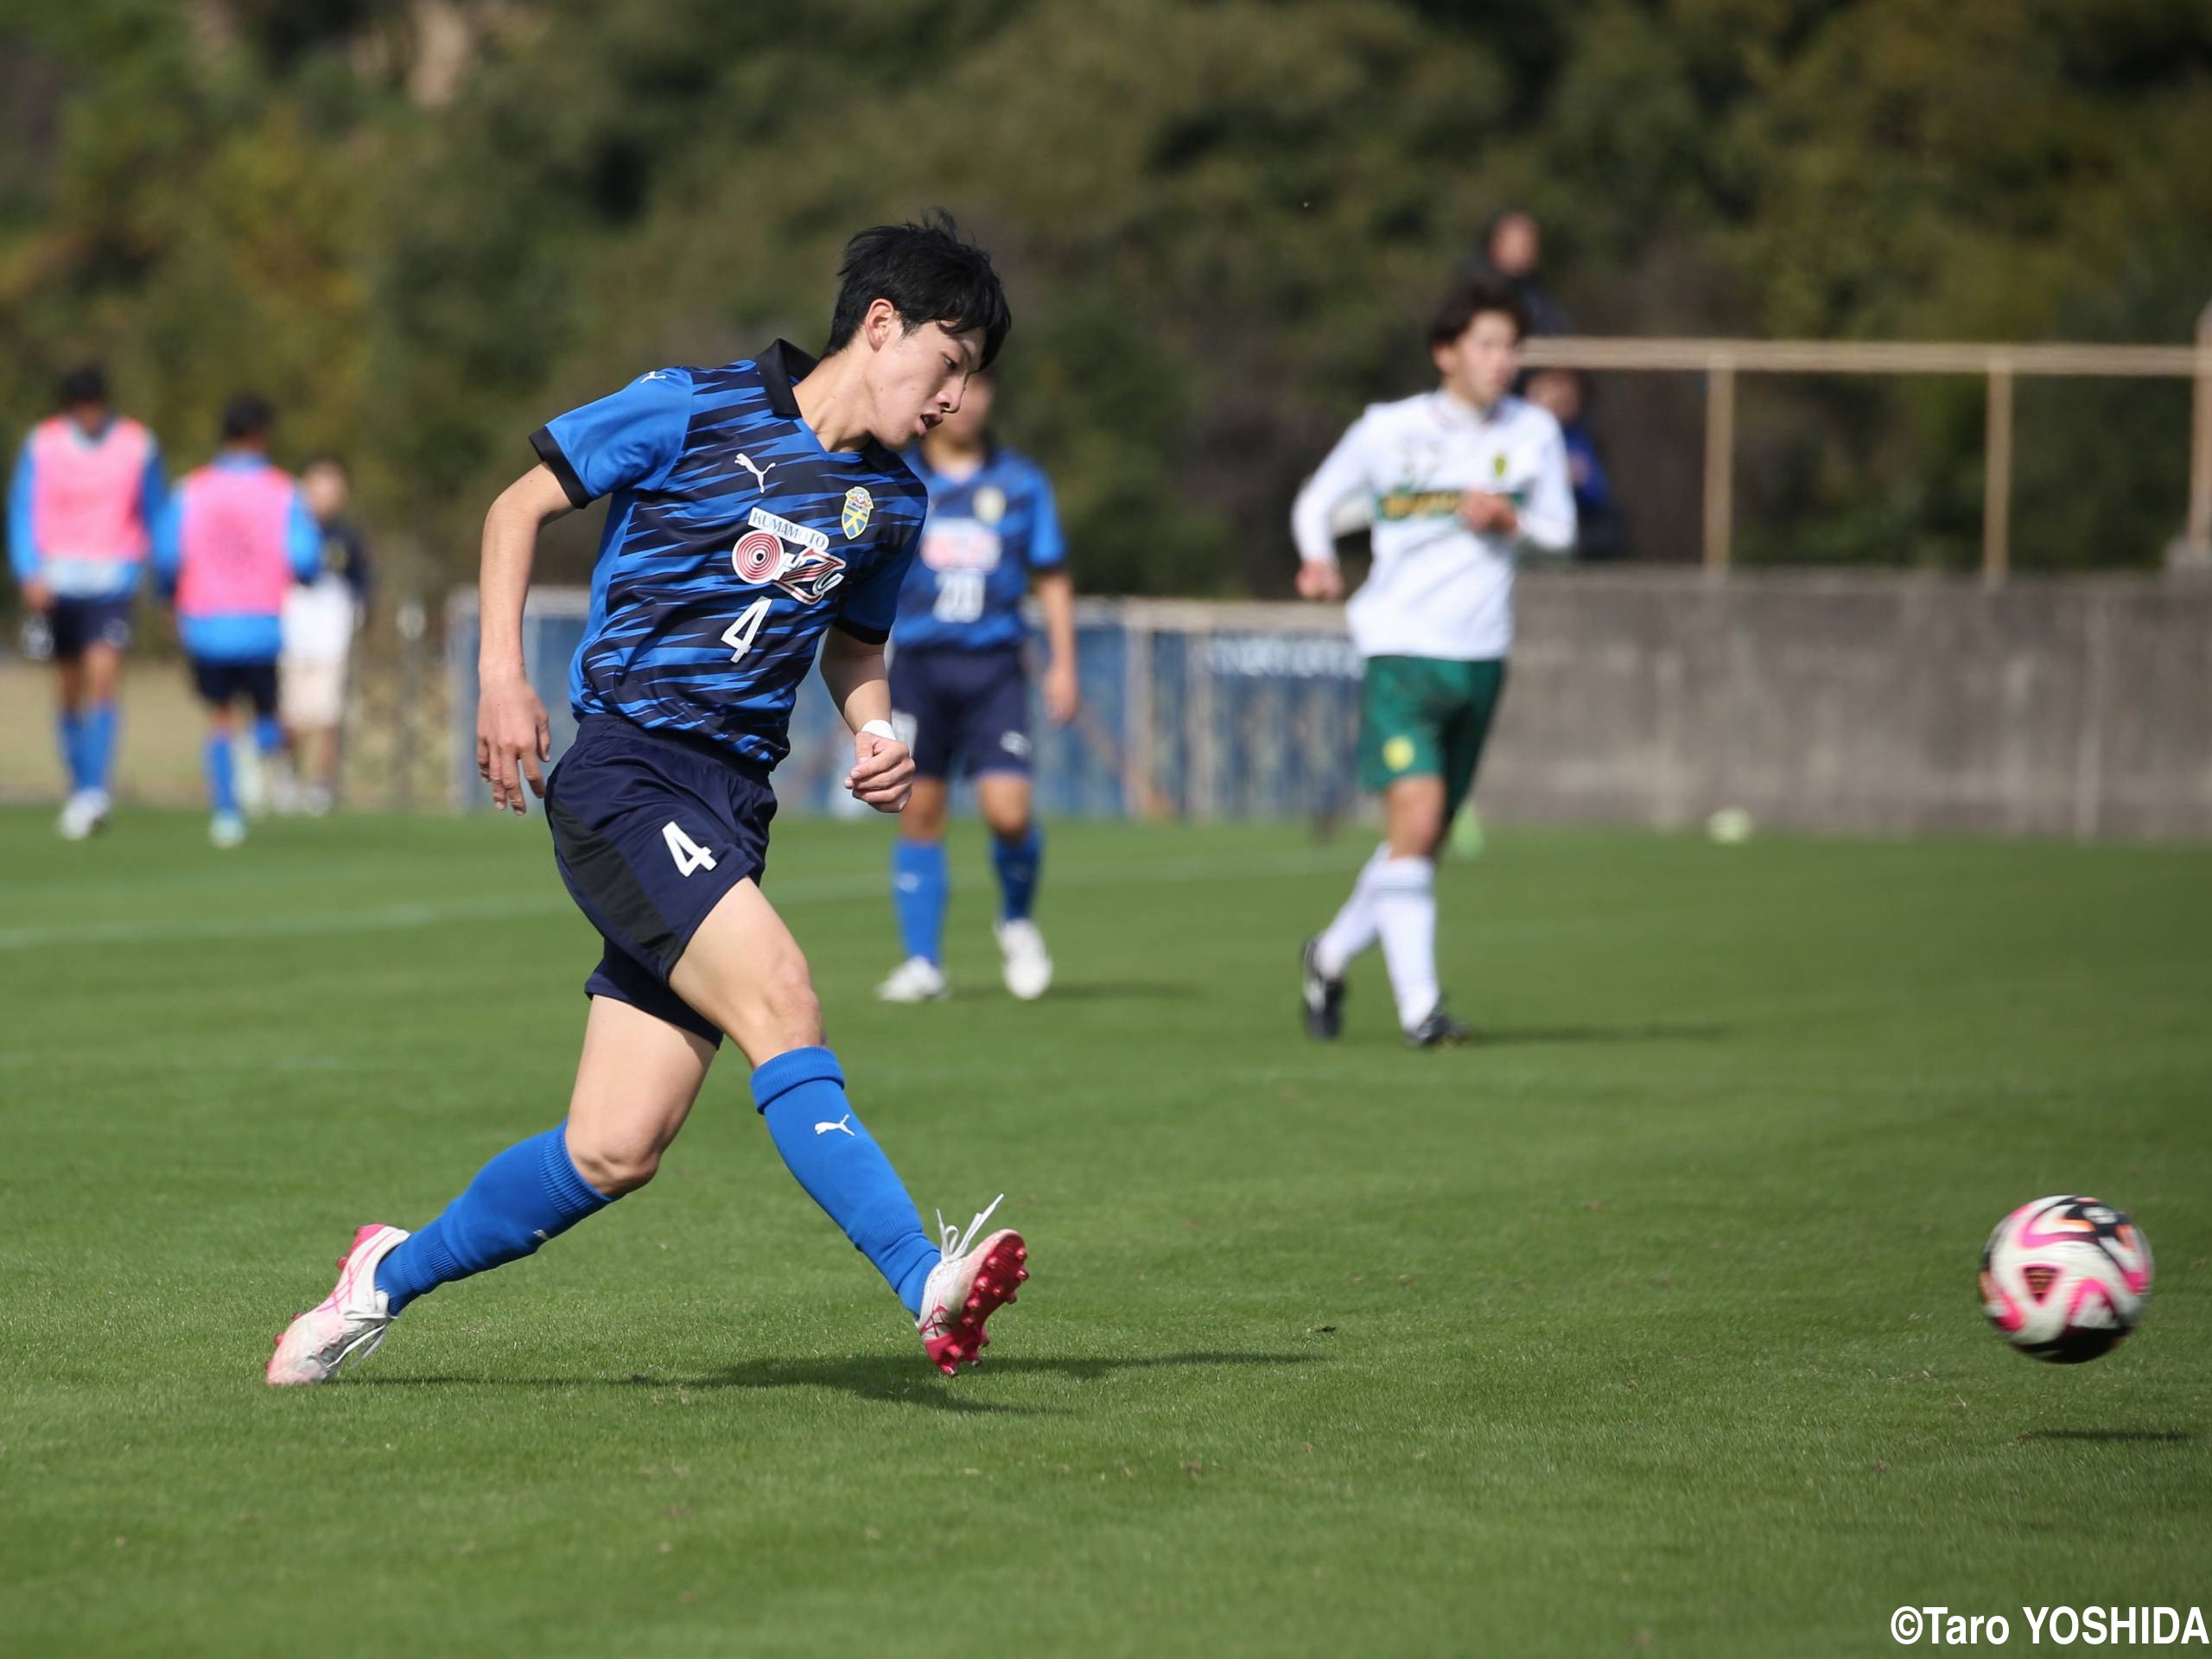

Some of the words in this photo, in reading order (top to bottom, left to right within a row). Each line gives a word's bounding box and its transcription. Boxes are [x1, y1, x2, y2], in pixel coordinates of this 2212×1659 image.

[751, 511, 827, 549] KUMAMOTO
[721, 595, 772, 663] 4
[661, 821, 718, 877] 4
